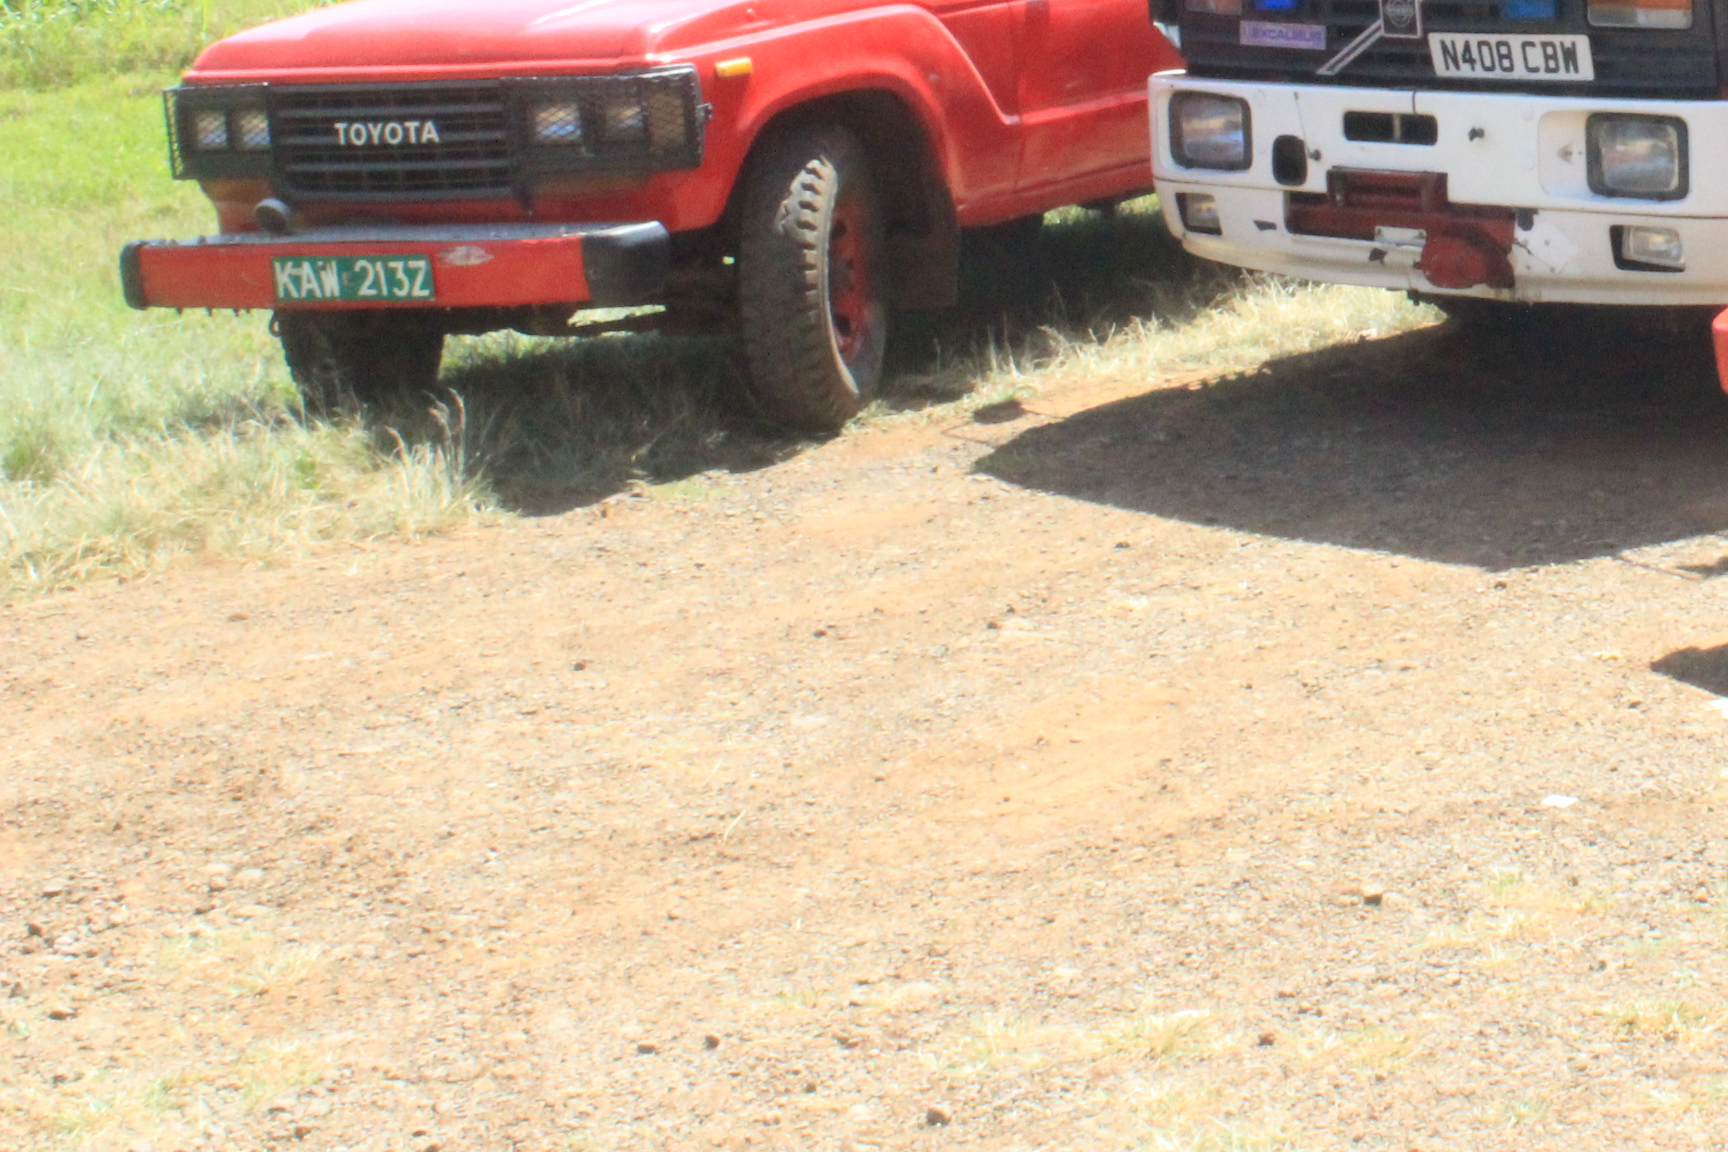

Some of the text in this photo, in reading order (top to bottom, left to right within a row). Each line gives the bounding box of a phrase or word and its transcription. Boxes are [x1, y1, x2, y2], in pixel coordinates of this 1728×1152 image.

[1439, 38, 1580, 76] N408 CBW
[332, 119, 441, 147] TOYOTA
[273, 259, 431, 299] KAW 213Z
